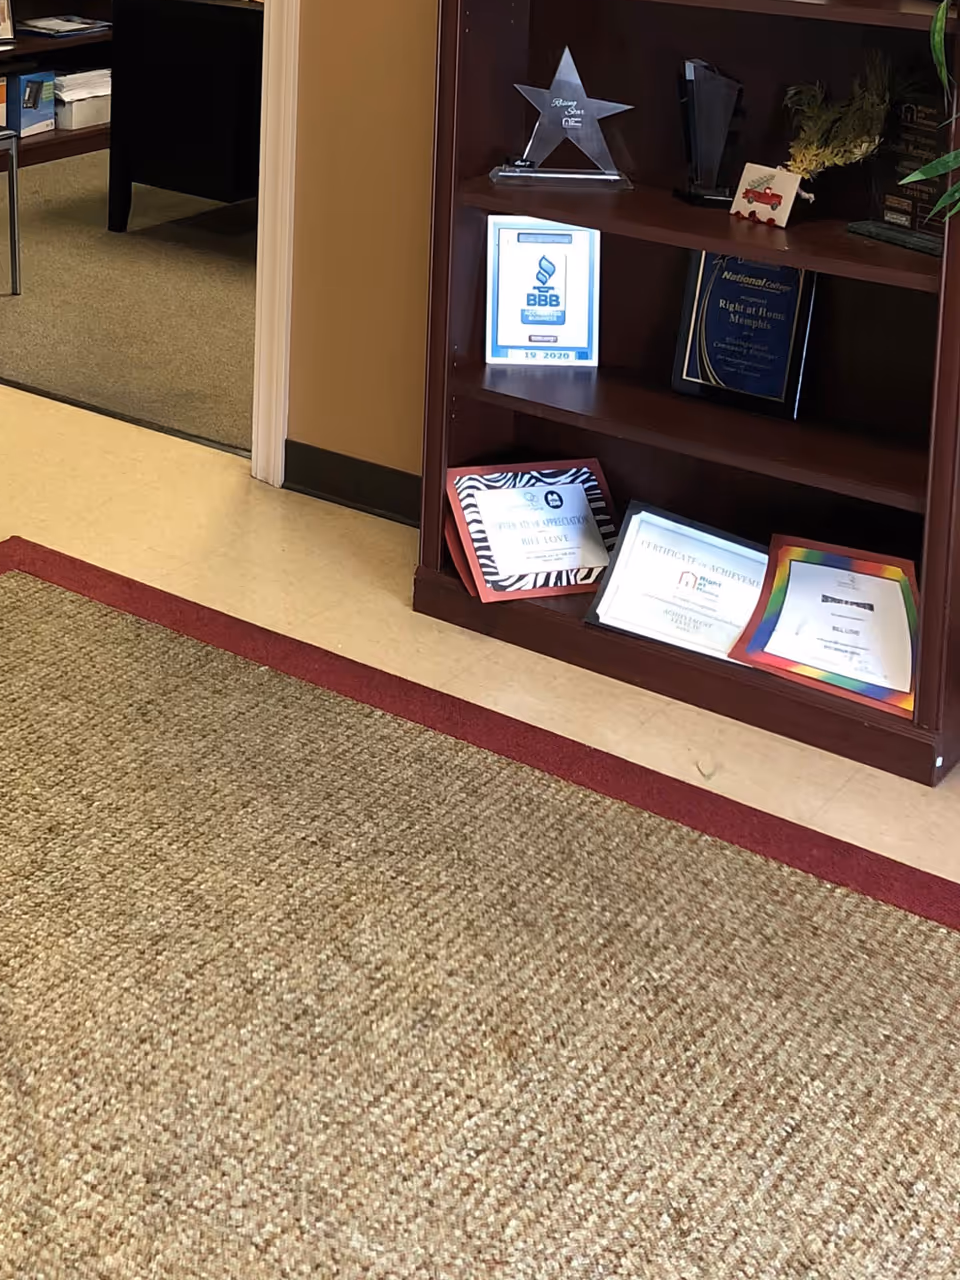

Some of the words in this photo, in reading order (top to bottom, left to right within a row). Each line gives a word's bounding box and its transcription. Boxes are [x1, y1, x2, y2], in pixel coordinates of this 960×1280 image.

[722, 271, 766, 286] National
[526, 293, 560, 307] BBB
[719, 299, 743, 313] Right
[729, 313, 771, 330] Memphis
[544, 533, 570, 545] LOVE
[640, 540, 696, 565] CERTIFICATE
[710, 564, 761, 590] ACHIEVEME
